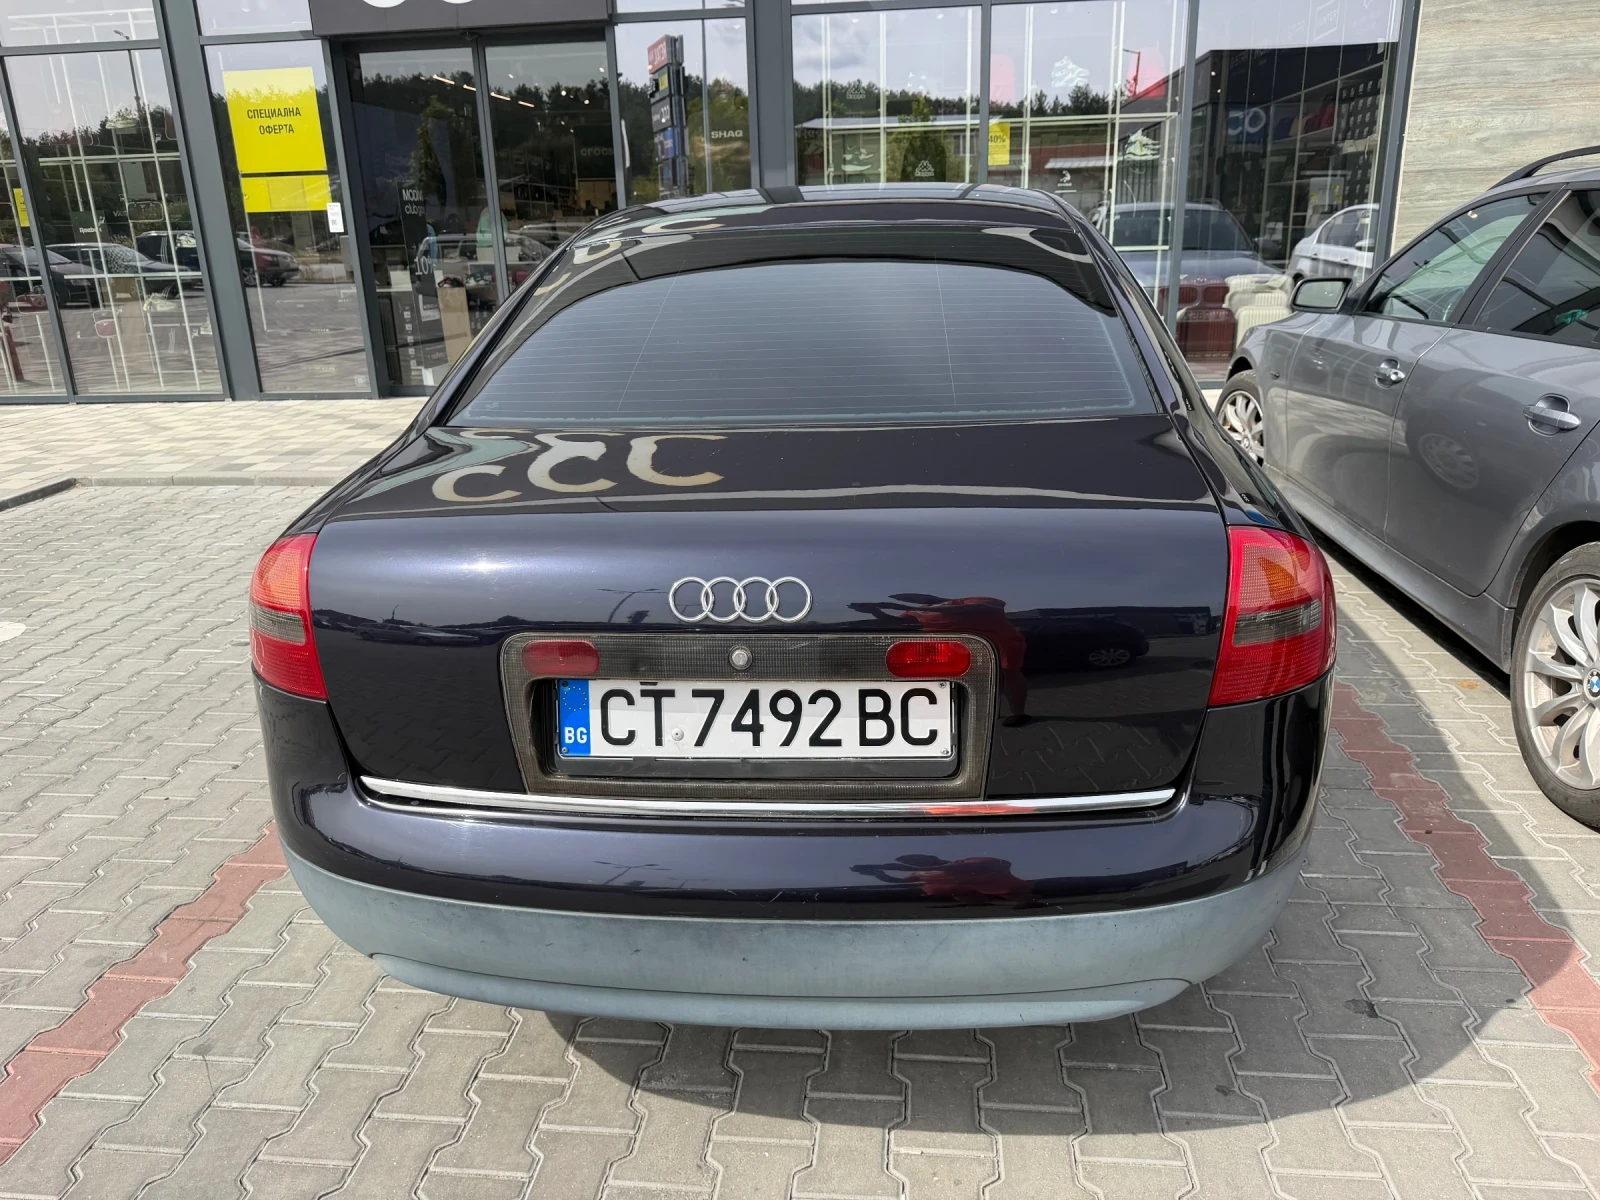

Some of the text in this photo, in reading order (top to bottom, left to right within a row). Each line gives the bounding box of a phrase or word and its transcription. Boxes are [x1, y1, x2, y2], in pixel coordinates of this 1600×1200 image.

[246, 106, 302, 120] СПЕЦИАЛНА
[258, 123, 295, 135] ОФЕРТА
[710, 129, 744, 139] SHAQ
[600, 688, 939, 747] CT 7492 BC
[564, 726, 588, 744] BG
